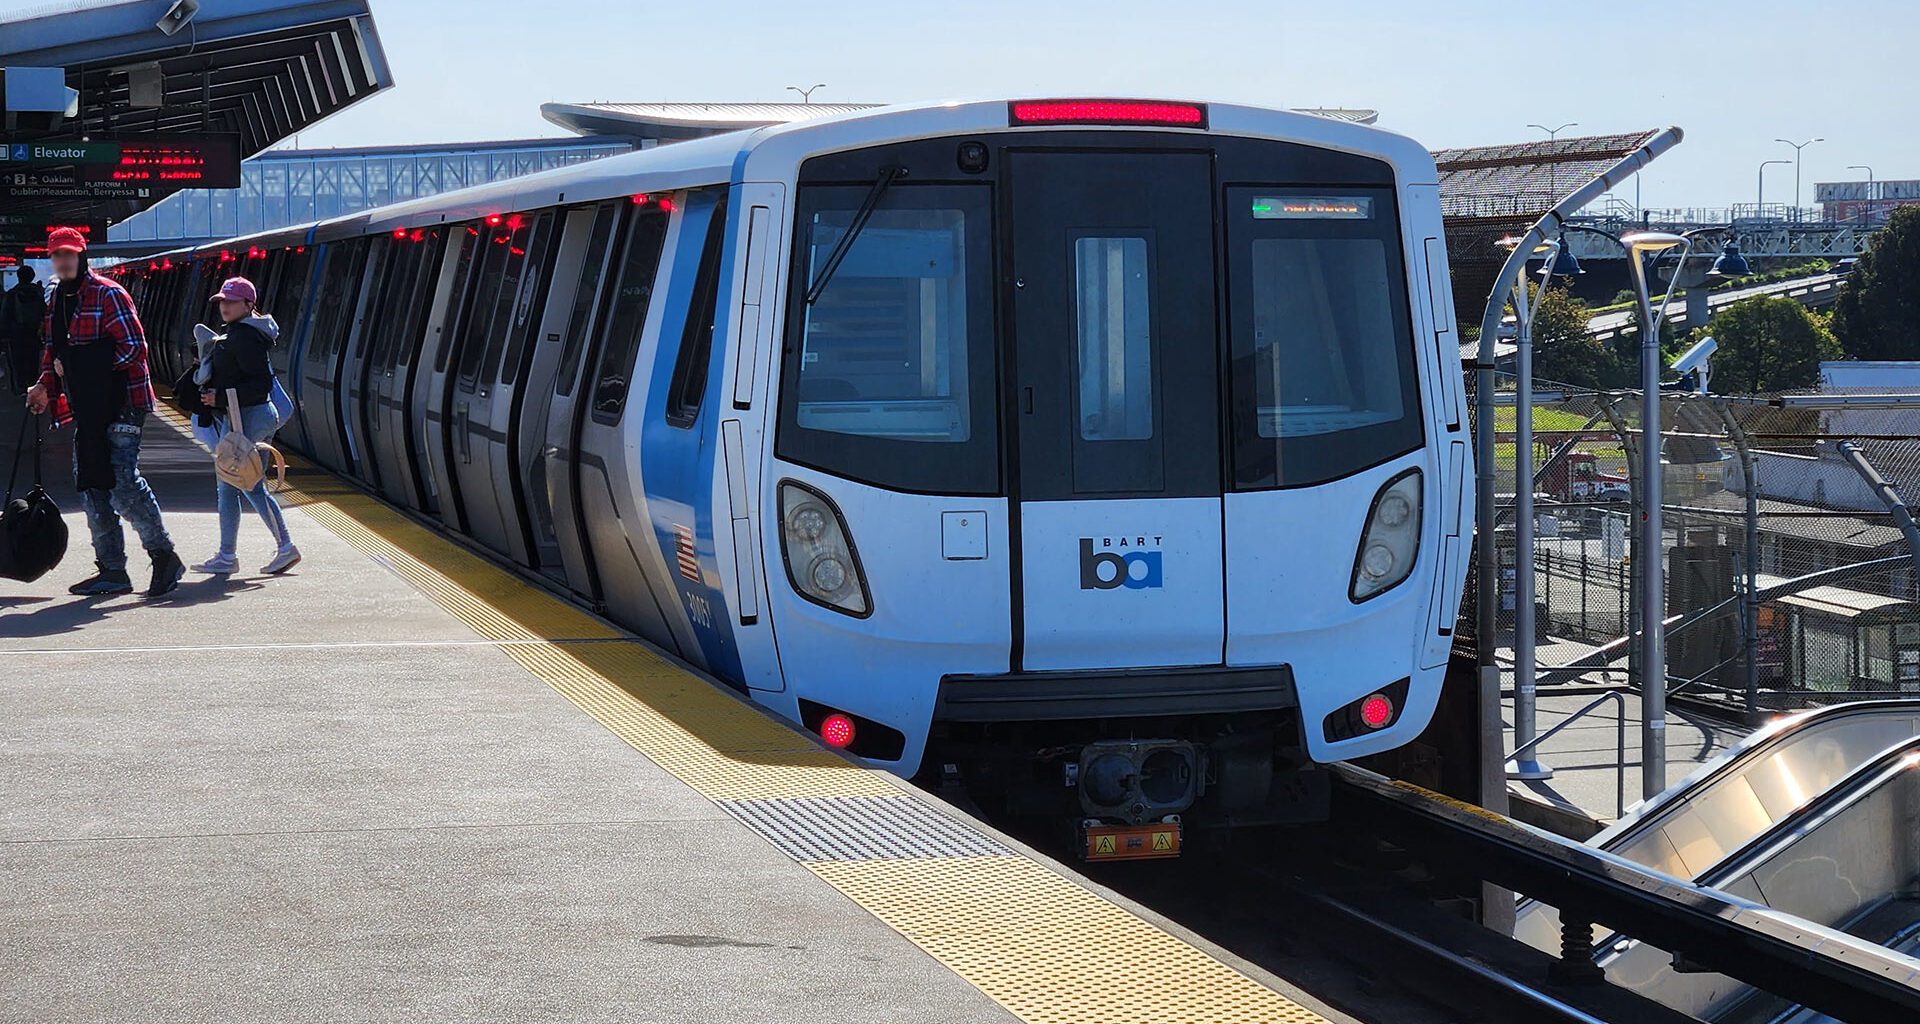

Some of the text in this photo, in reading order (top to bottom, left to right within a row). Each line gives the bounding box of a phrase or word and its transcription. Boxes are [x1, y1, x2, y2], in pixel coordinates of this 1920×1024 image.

[35, 146, 86, 158] Elevator
[42, 174, 73, 183] Oaklan
[10, 188, 92, 197] Dublin/Pleasanton,
[94, 188, 135, 198] Berryessa
[1103, 536, 1162, 547] BART
